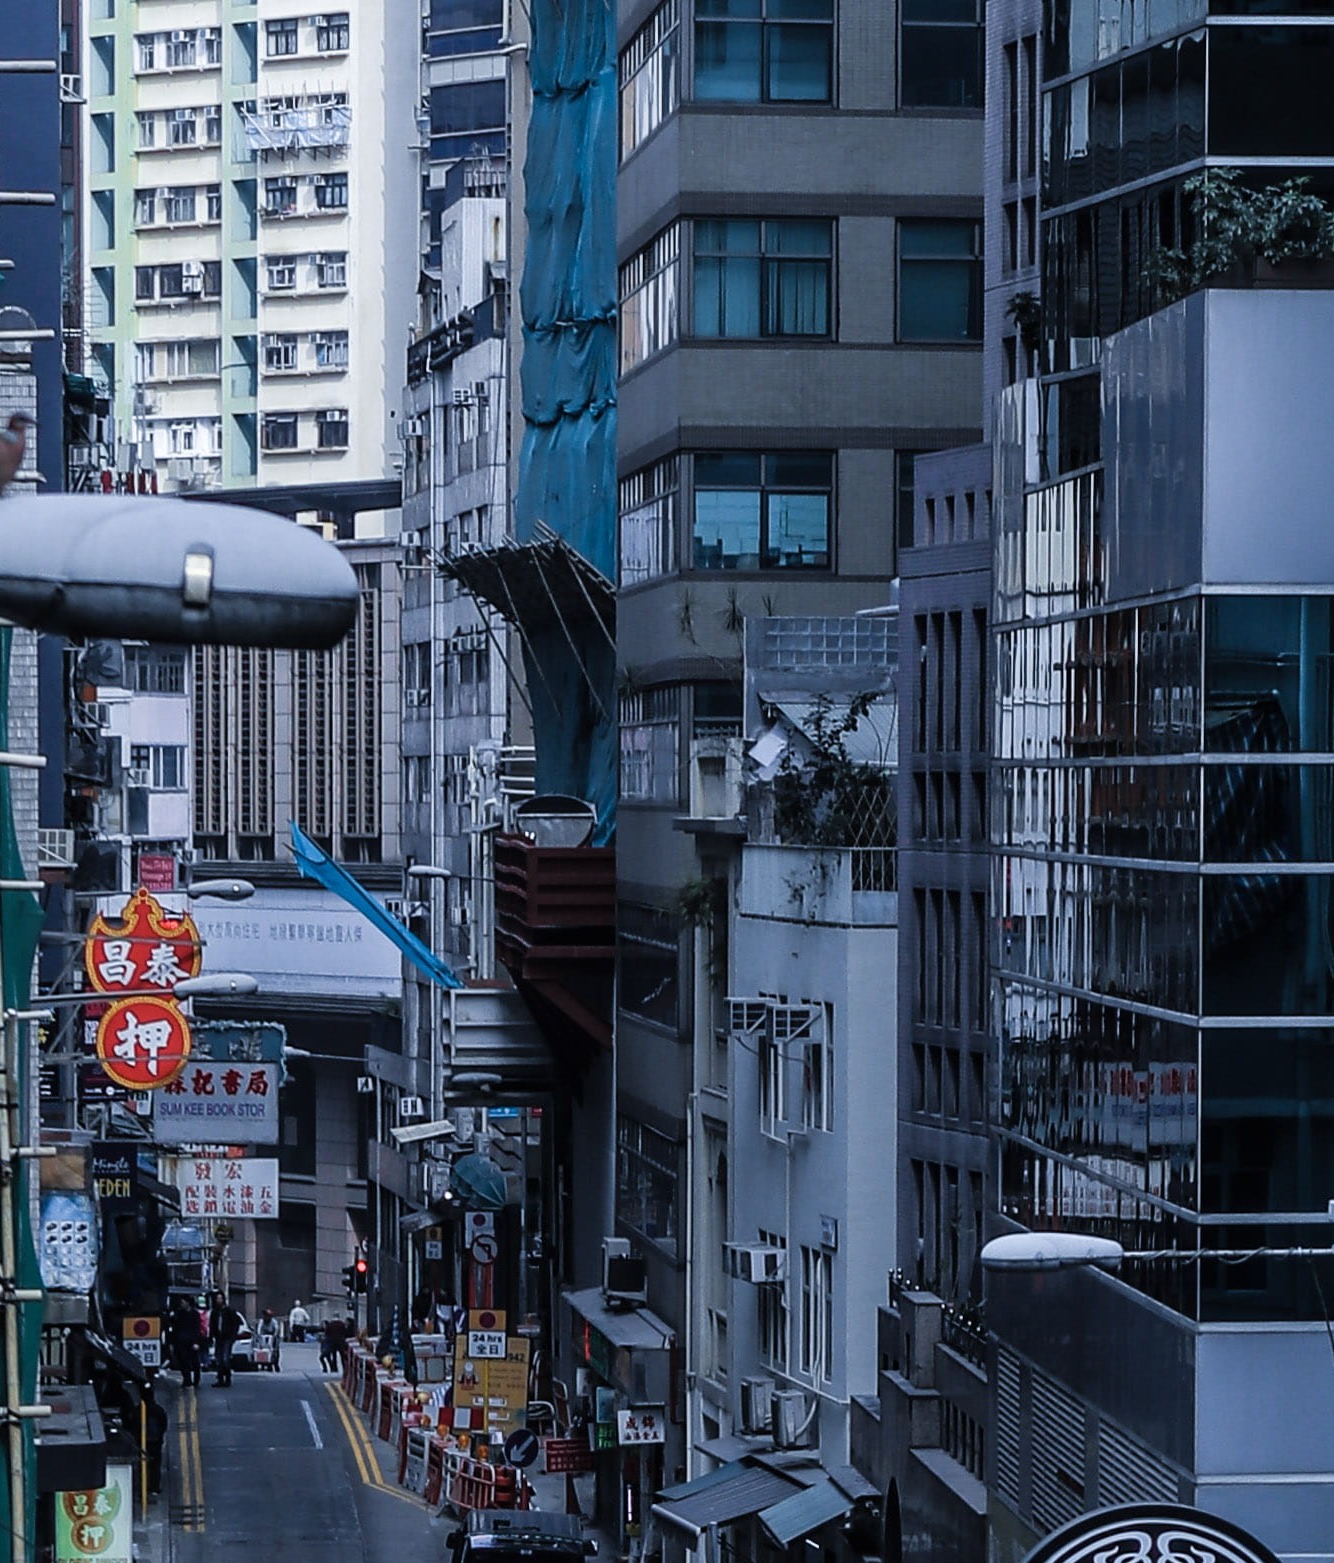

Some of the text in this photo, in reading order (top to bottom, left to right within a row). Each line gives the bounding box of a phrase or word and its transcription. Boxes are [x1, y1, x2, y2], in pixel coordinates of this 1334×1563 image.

[113, 1010, 174, 1077] 押
[159, 1103, 265, 1118] SUM KEE BOOK STOR
[471, 1333, 503, 1343] 24 hrs
[475, 1344, 499, 1355] 全日
